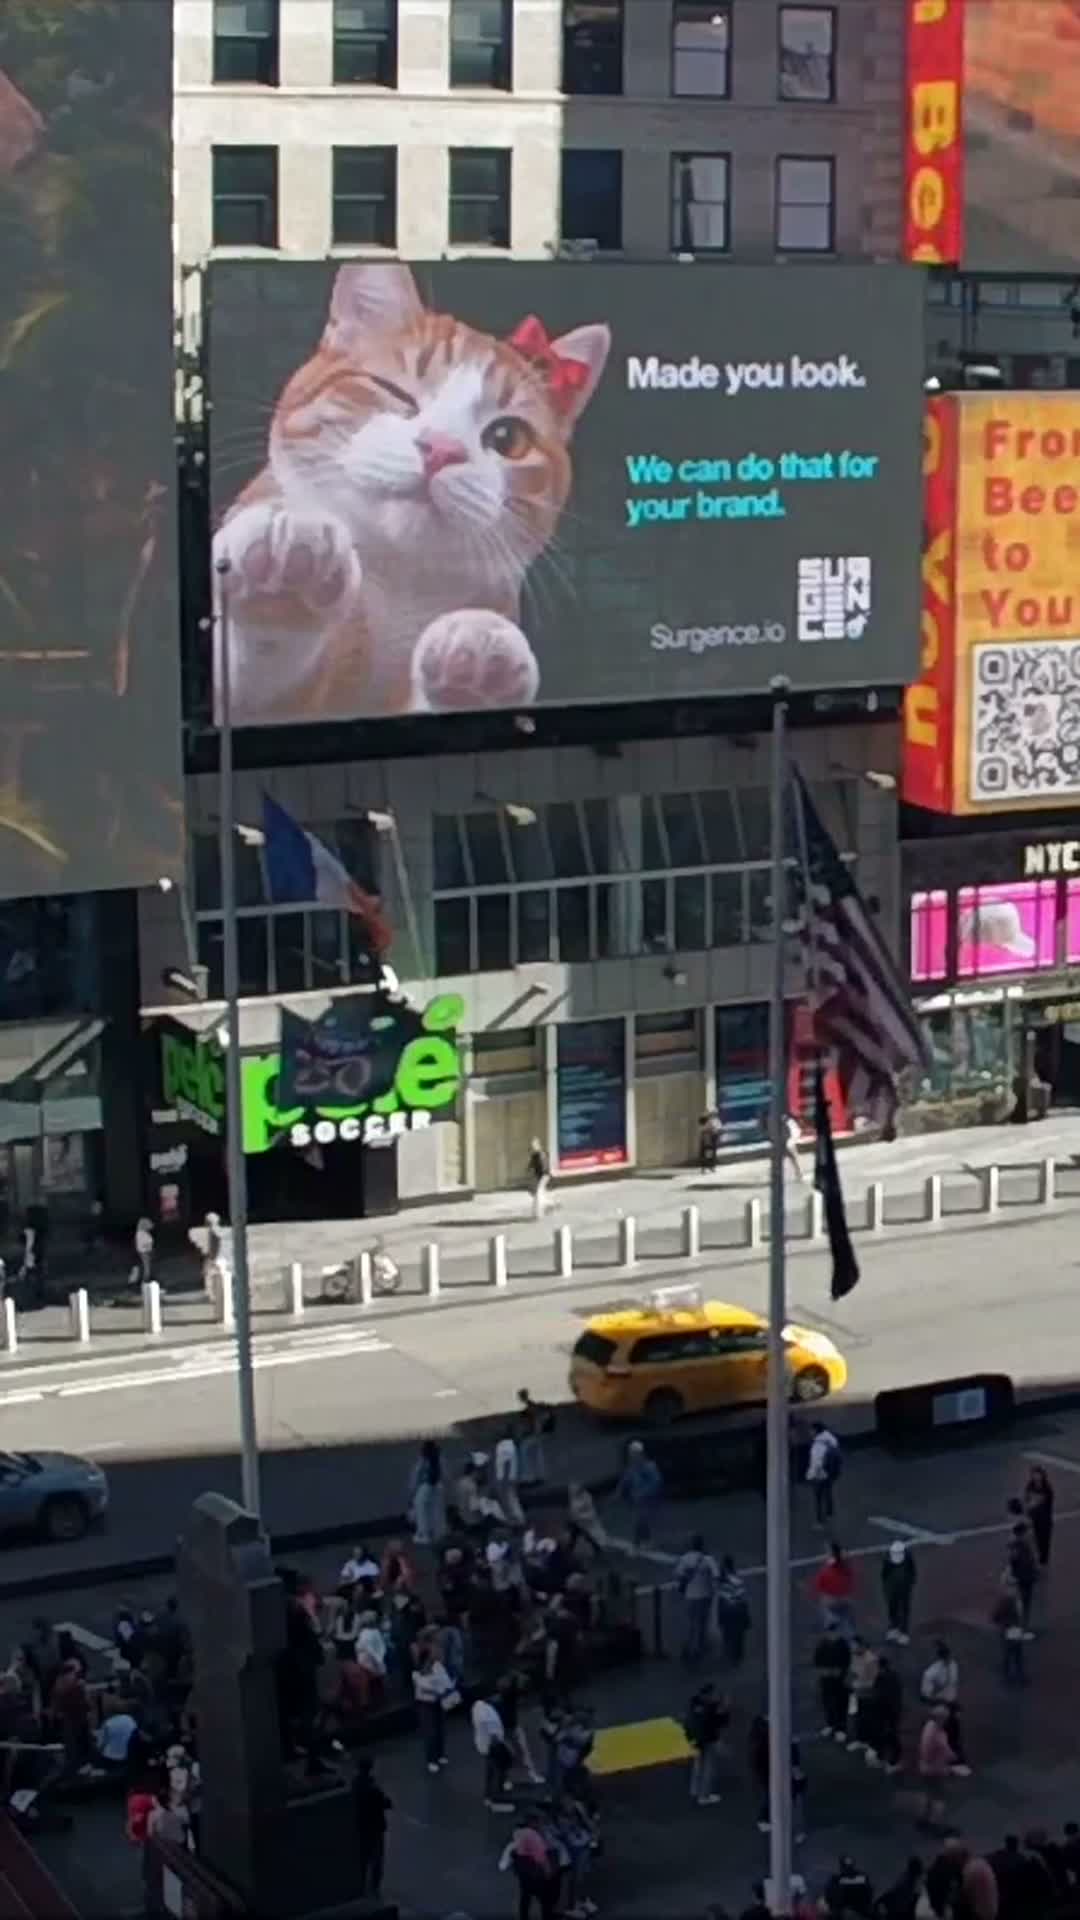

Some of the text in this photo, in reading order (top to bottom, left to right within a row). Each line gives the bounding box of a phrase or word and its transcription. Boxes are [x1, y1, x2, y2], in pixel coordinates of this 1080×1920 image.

[627, 355, 866, 394] Made you look.
[626, 450, 878, 483] We can do that for
[626, 489, 786, 526] your brand.
[982, 532, 1030, 572] to
[981, 589, 1073, 628] You
[651, 619, 786, 653] Surgence.io
[1024, 841, 1080, 875] NYC
[290, 1110, 433, 1148] SOCCER
